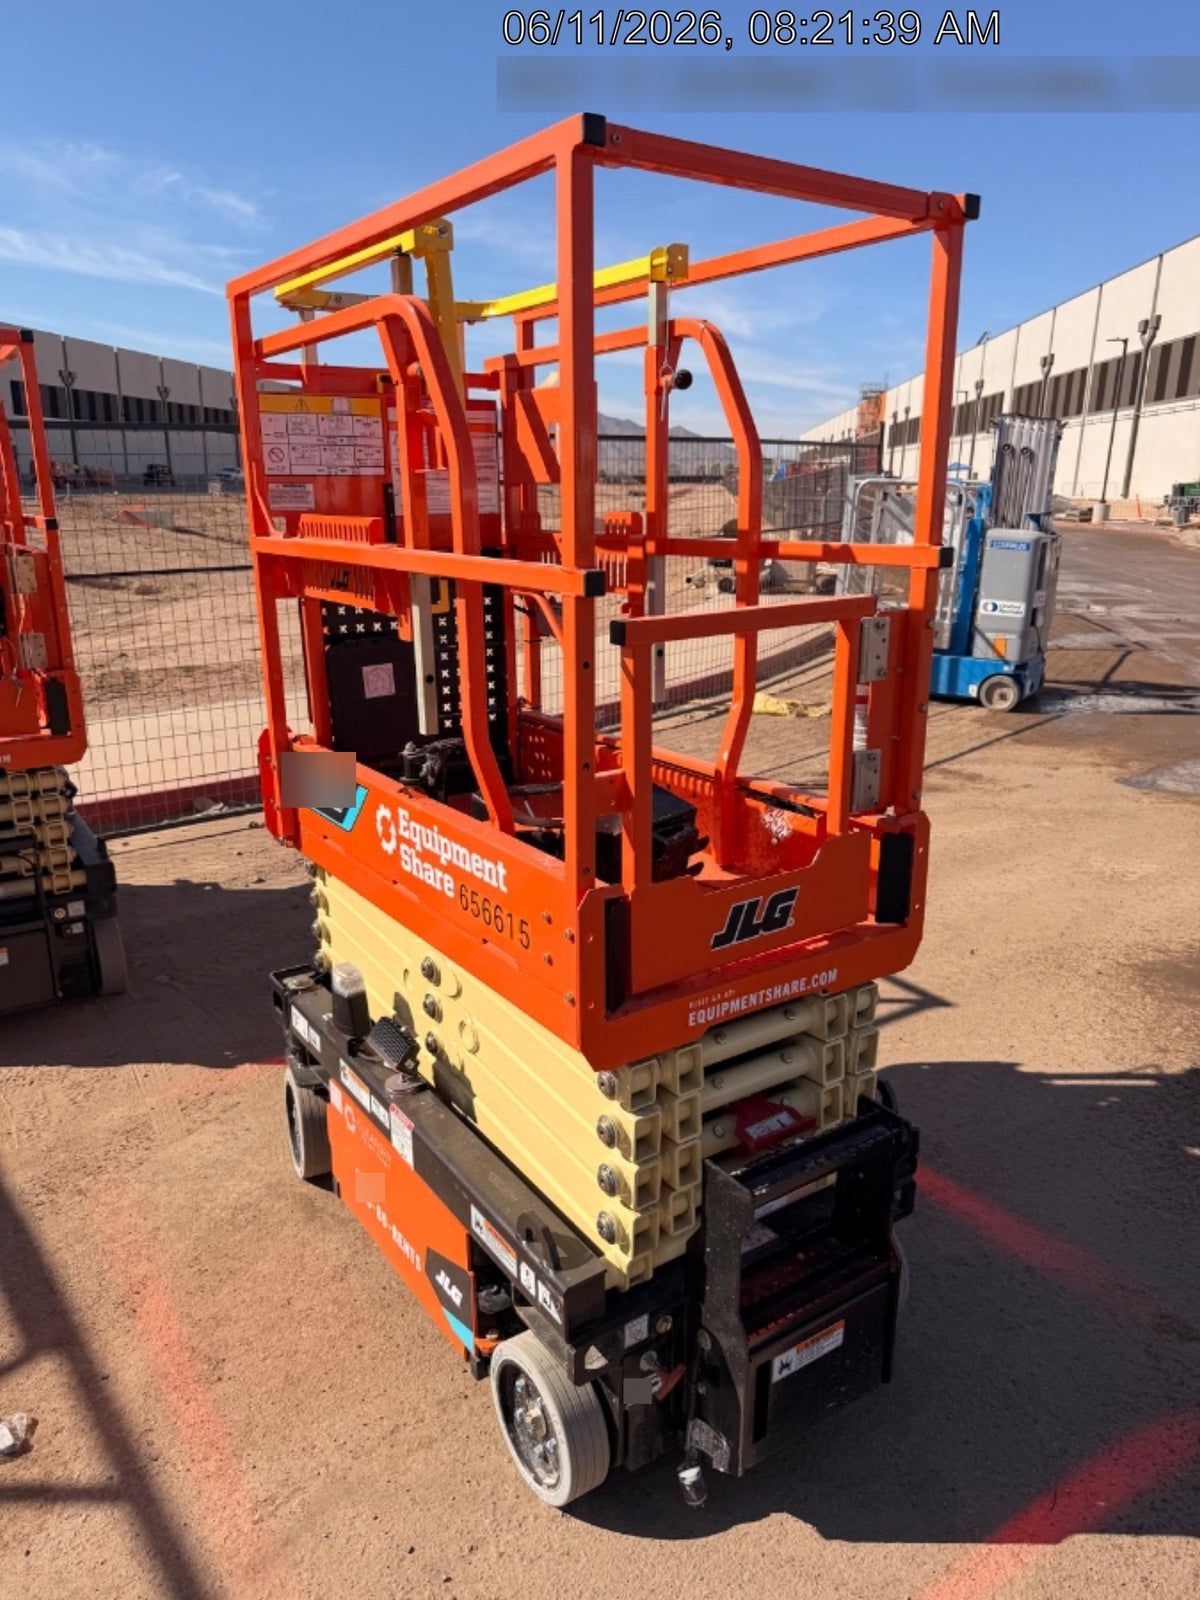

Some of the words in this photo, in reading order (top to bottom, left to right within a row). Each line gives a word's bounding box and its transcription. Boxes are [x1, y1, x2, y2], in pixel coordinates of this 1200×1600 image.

[397, 806, 508, 893] Equipment
[399, 842, 455, 898] Share
[459, 883, 531, 950] 656615
[711, 885, 801, 952] JLG
[688, 968, 838, 1027] EQUIPMENTSHARE.COM
[434, 1268, 463, 1307] JLG
